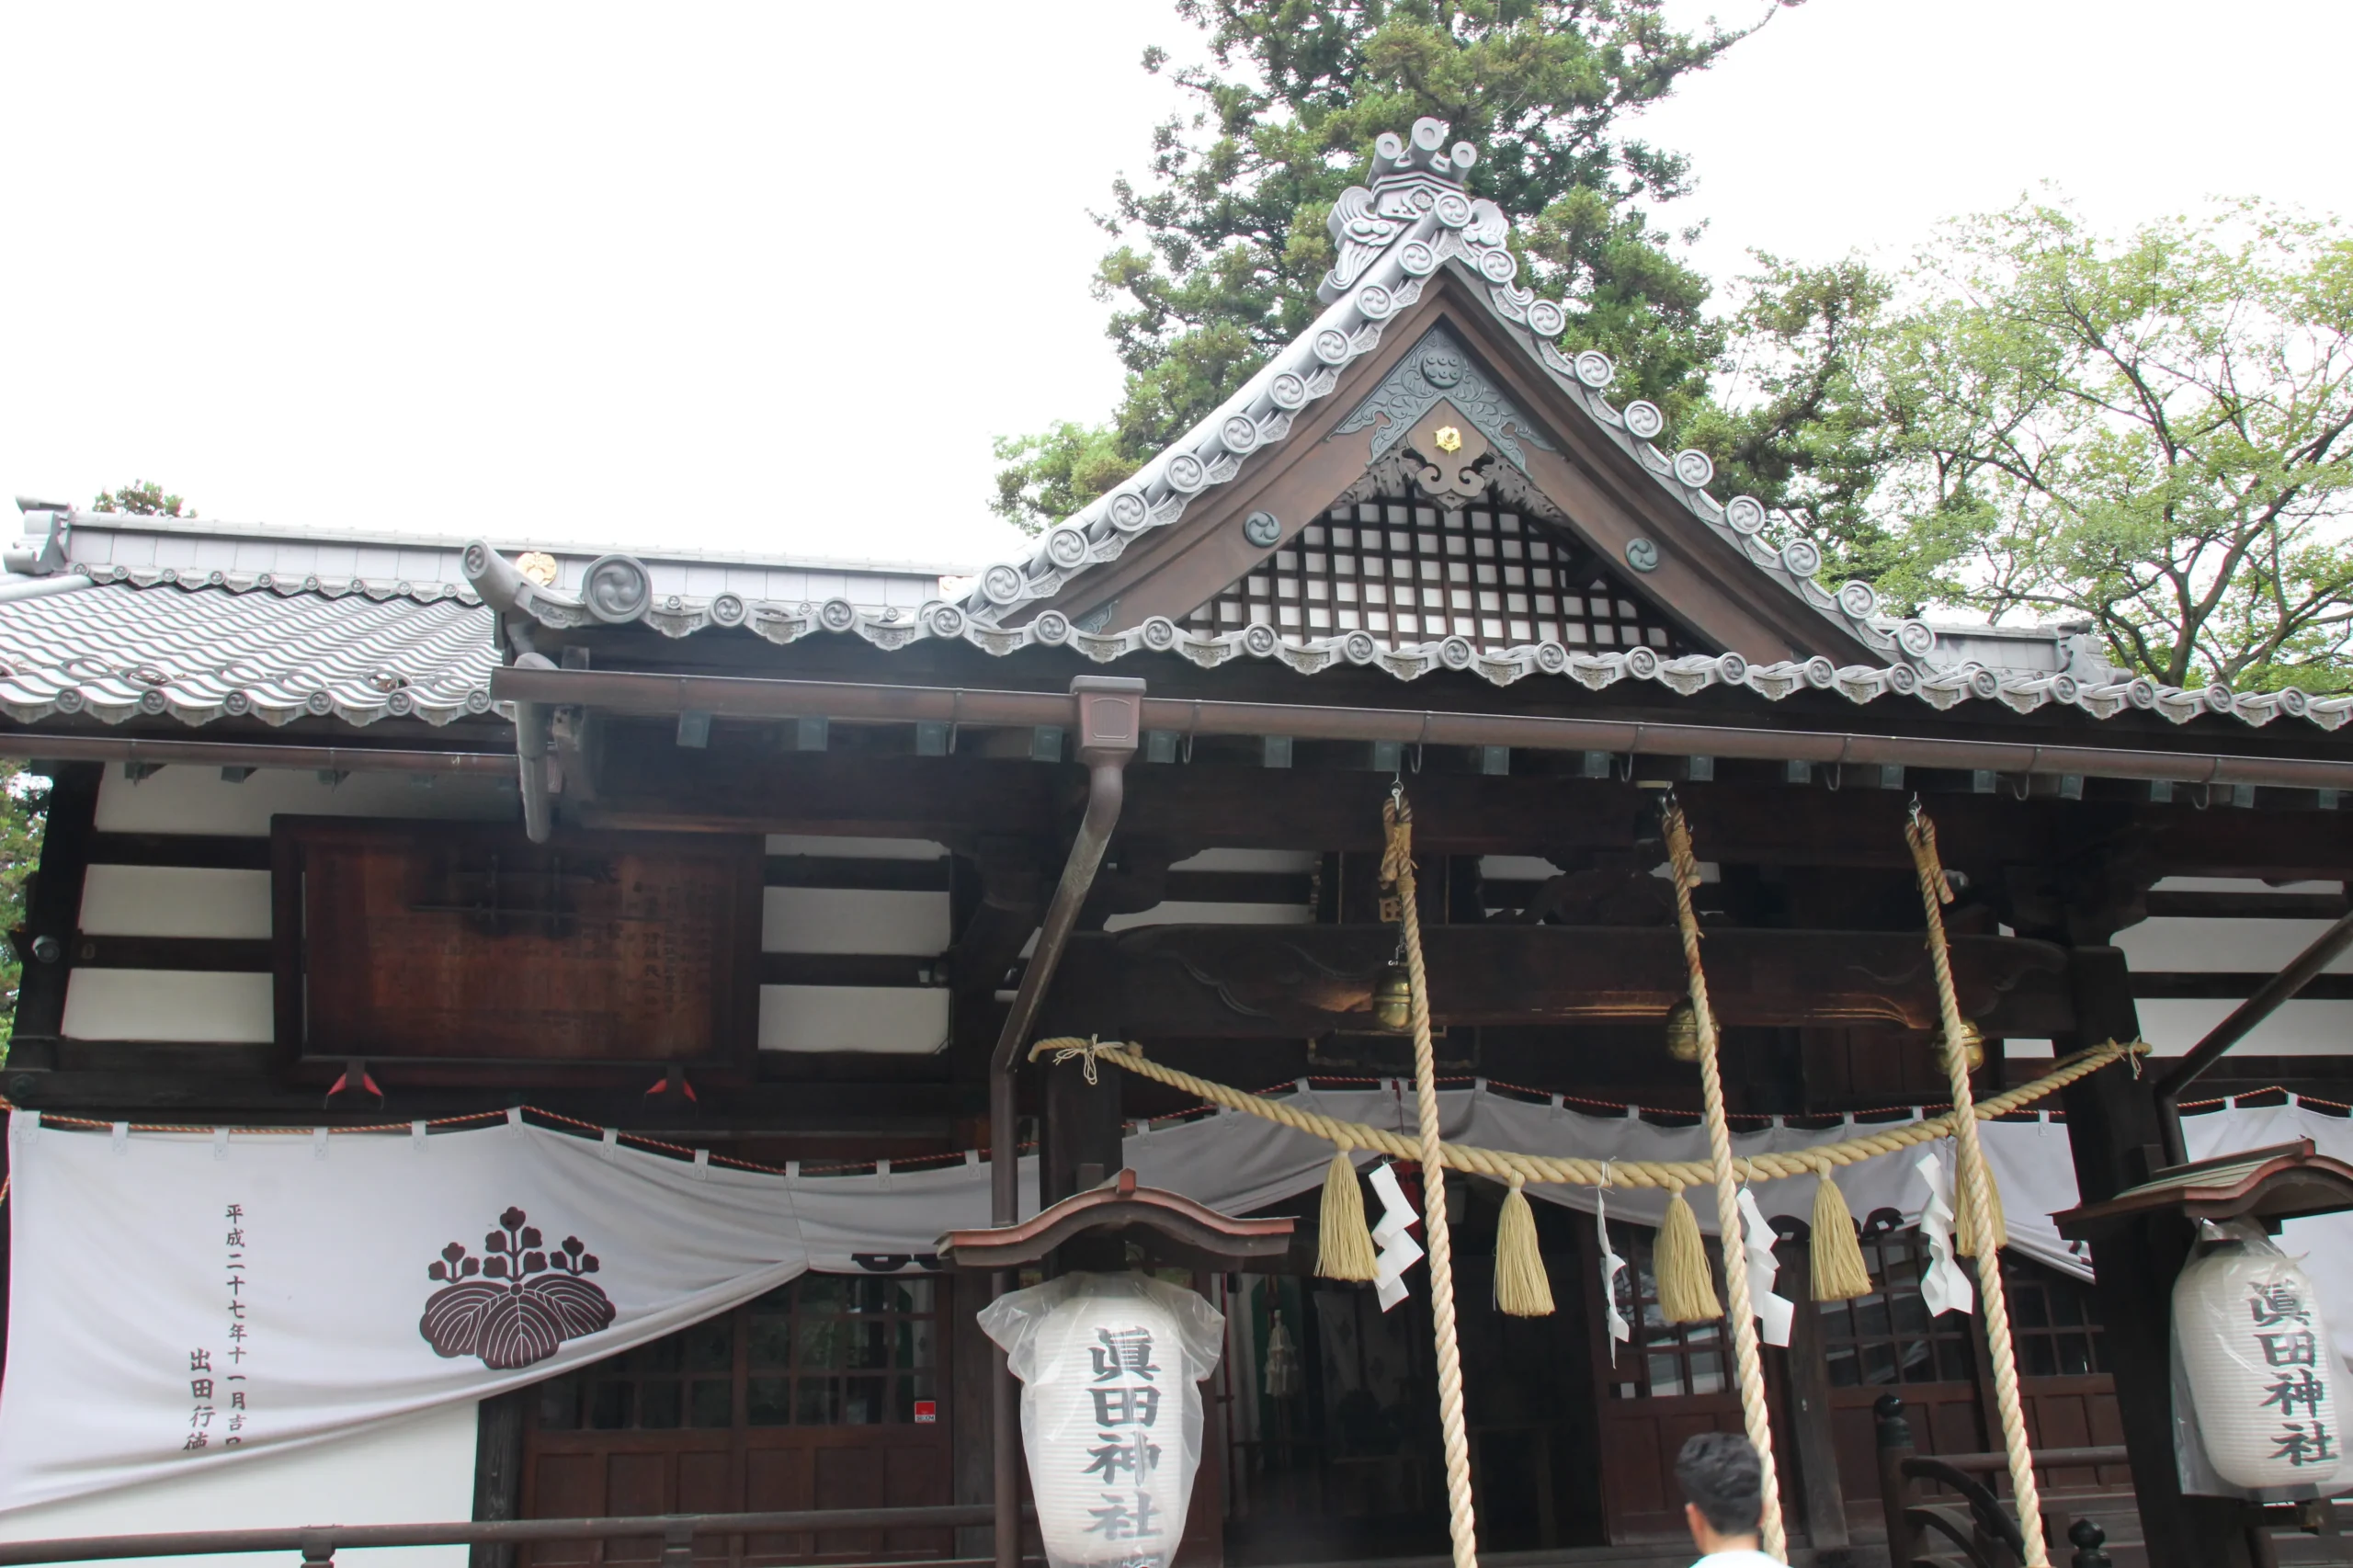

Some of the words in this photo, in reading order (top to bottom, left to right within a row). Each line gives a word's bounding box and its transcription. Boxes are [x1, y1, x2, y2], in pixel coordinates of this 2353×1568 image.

[1081, 1324, 1164, 1540] 眞田神社
[2246, 1278, 2339, 1466] 眞田神社
